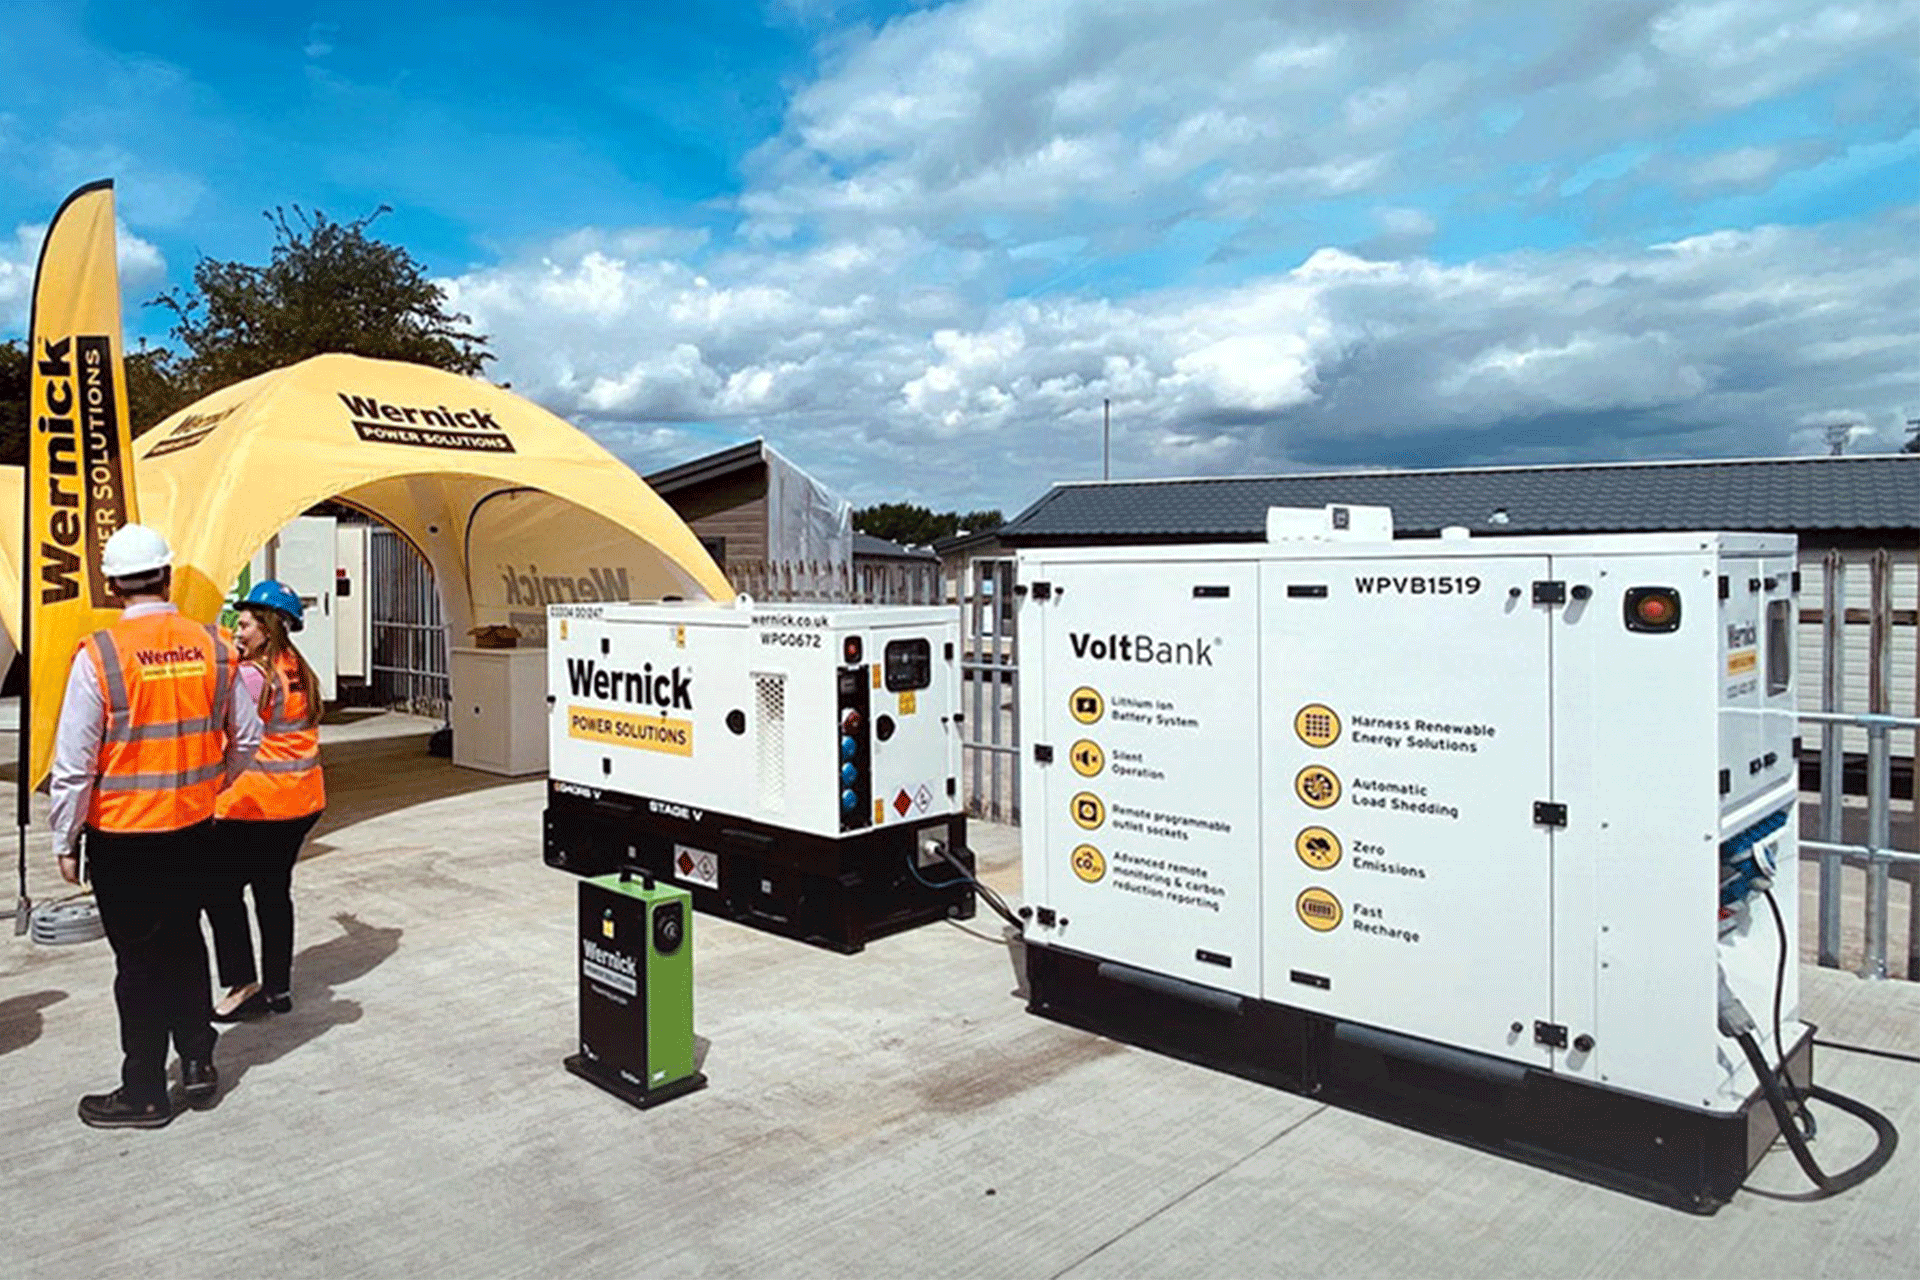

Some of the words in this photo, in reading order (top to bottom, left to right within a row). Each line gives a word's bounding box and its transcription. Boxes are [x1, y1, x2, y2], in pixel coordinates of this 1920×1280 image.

[337, 391, 501, 429] Wernick
[85, 349, 114, 500] SOLUTIONS
[362, 426, 421, 443] POWER
[422, 433, 507, 448] SOLUTIONS
[38, 335, 81, 605] Wernick
[1355, 576, 1481, 594] WPVB1519
[751, 613, 829, 628] wernick.co.uk
[761, 632, 821, 649] WPG0672
[1069, 633, 1213, 666] VoltBank
[137, 645, 205, 665] Wernick
[567, 658, 692, 710] Wernick
[1111, 697, 1153, 709] Lithium
[572, 715, 612, 735] POWER
[615, 721, 687, 745] SOLUTIONS
[1111, 710, 1153, 725] Battery
[1156, 714, 1199, 728] System
[1352, 716, 1410, 730] Harness
[1415, 720, 1496, 737] Renewable
[1352, 731, 1401, 748] Energy
[1407, 736, 1478, 753] Solutions
[1112, 750, 1143, 763] Silent
[1112, 763, 1164, 779] Operation
[1352, 778, 1428, 797] Automatic
[649, 801, 690, 820] STAGE
[693, 810, 703, 821] V
[1352, 794, 1386, 808] Load
[1391, 798, 1459, 819] Shedding
[1113, 804, 1151, 820] Remote
[1154, 812, 1232, 833] programmable
[1113, 820, 1144, 832] outlet
[1147, 826, 1189, 841] sockets
[1353, 840, 1385, 856] Zero
[1113, 852, 1165, 870] Advanced
[1167, 864, 1207, 878] remote
[1353, 857, 1426, 879] Emissions
[1113, 866, 1171, 887] monitoring
[1174, 877, 1182, 888] &
[1185, 881, 1225, 896] carbon
[1113, 880, 1164, 898] reduction
[1166, 892, 1219, 912] reporting
[1353, 903, 1383, 919] Fast
[1353, 920, 1420, 943] Recharge
[583, 939, 636, 977] Wernick
